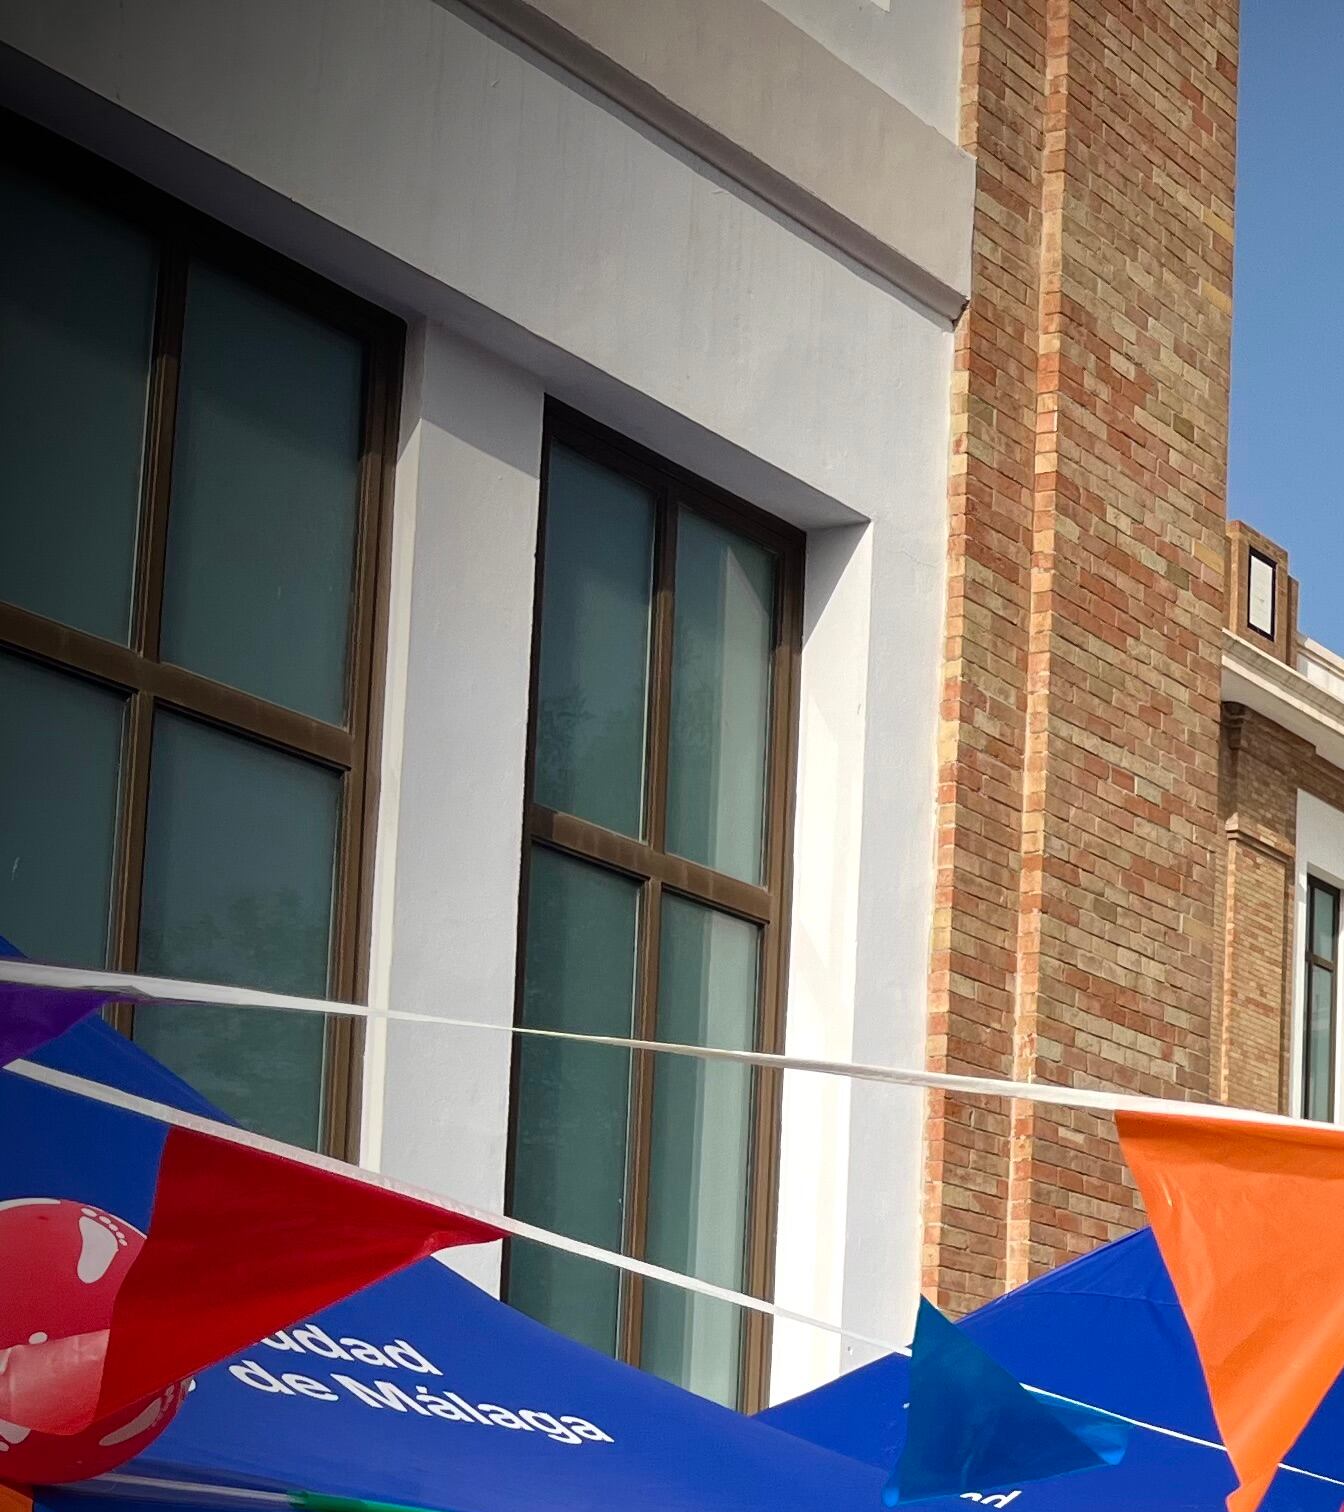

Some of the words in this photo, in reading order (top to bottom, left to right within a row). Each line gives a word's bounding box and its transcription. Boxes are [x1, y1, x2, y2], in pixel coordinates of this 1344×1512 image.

[258, 1323, 444, 1376] udad
[228, 1360, 339, 1401] de
[330, 1373, 615, 1446] Málaga
